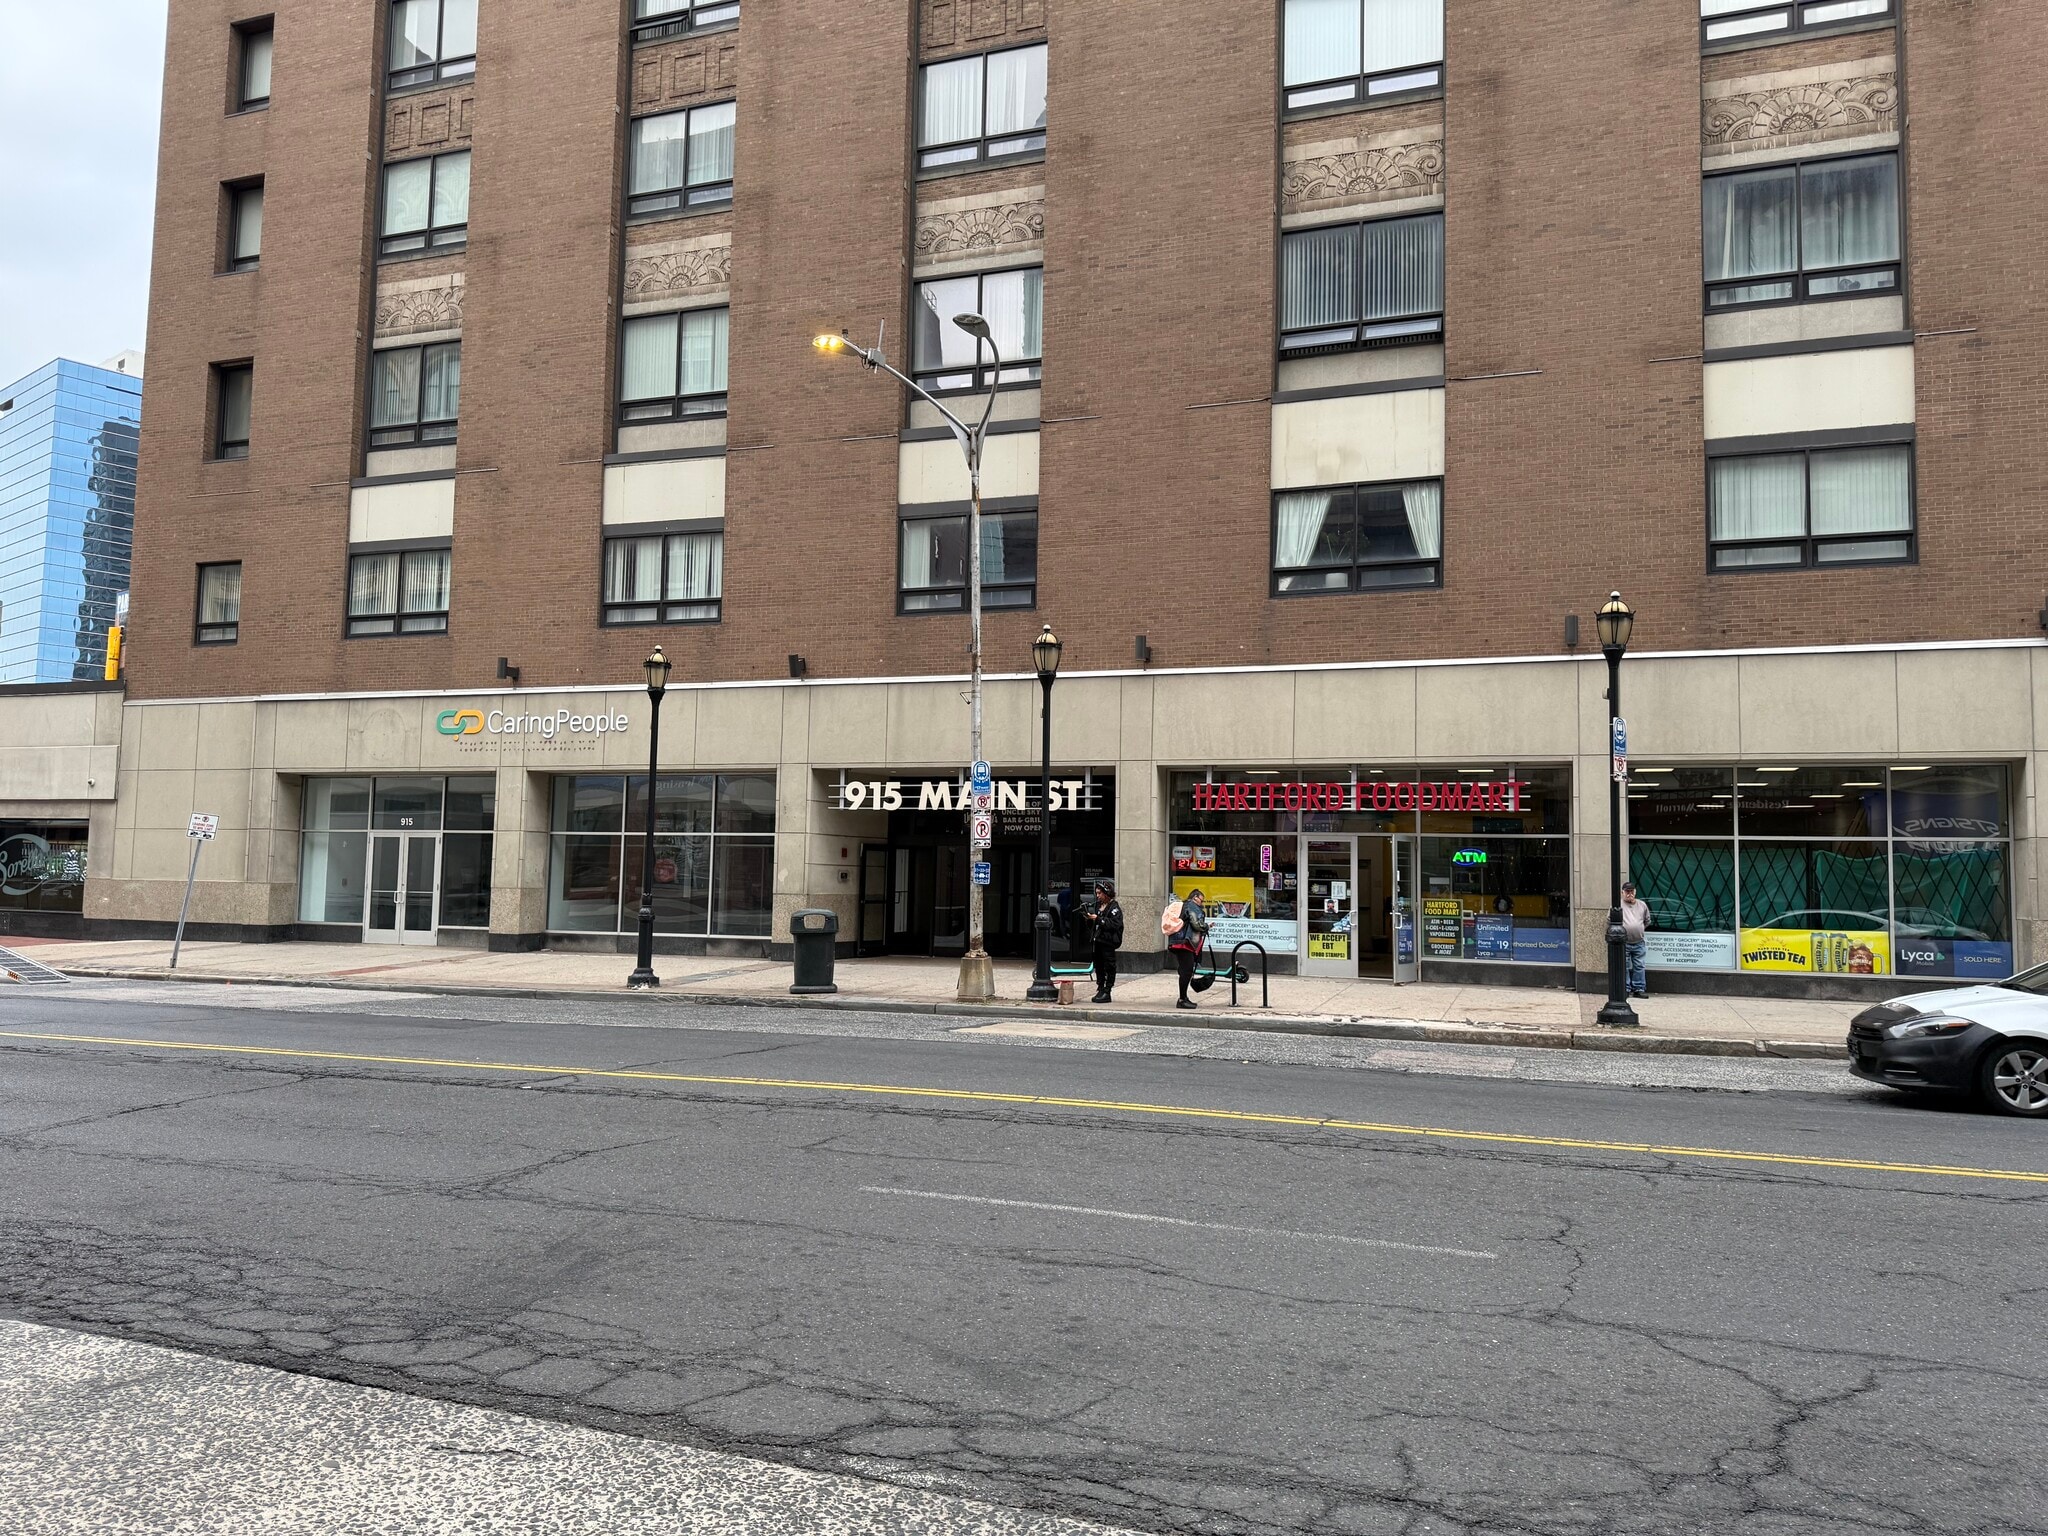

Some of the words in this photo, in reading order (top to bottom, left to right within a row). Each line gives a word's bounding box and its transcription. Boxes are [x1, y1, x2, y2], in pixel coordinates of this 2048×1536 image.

[487, 707, 629, 739] CaringPeople
[845, 781, 902, 811] 915
[1048, 781, 1083, 811] ST
[1195, 783, 1344, 811] HARTFORD
[1355, 781, 1526, 812] FOODMART
[401, 817, 414, 826] 915
[1262, 846, 1270, 871] OPEN
[1452, 851, 1487, 863] ATM
[1178, 859, 1190, 868] 127
[1477, 924, 1509, 932] Unlimited
[1309, 933, 1320, 941] WE
[1321, 934, 1346, 942] ACCEPT
[1322, 942, 1334, 950] EBT
[1742, 950, 1786, 964] TWISTED
[1787, 953, 1806, 966] TEA
[1901, 949, 1935, 962] Lyca
